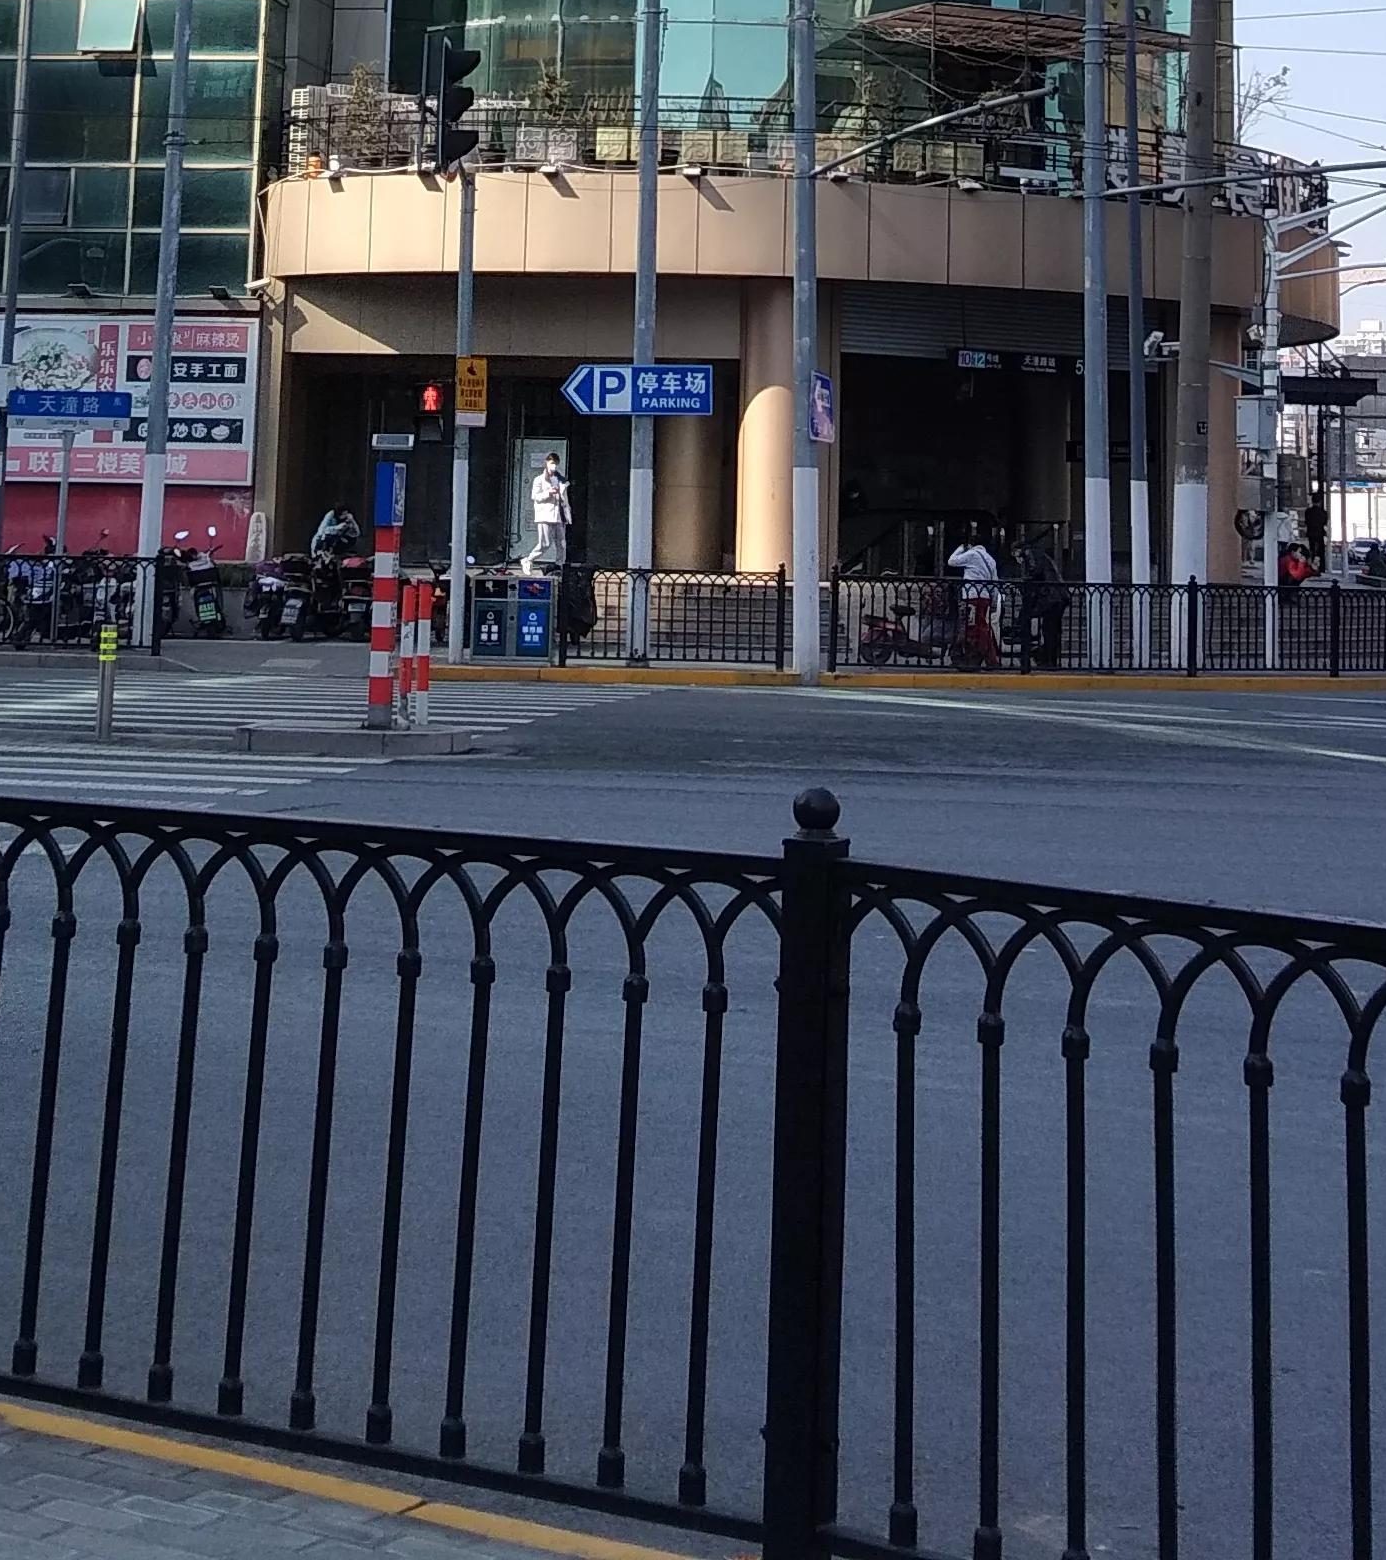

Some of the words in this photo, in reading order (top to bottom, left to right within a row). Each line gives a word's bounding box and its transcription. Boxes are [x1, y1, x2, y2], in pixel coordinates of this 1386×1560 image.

[196, 332, 240, 348] 麻辣烫
[173, 362, 239, 378] 安手工面
[598, 370, 627, 409] P
[637, 371, 705, 394] 停车场
[38, 395, 100, 415] 天潼路
[641, 397, 700, 409] PARKING
[15, 418, 25, 426] W
[113, 420, 120, 428] E
[28, 450, 188, 477] 联富二楼美城
